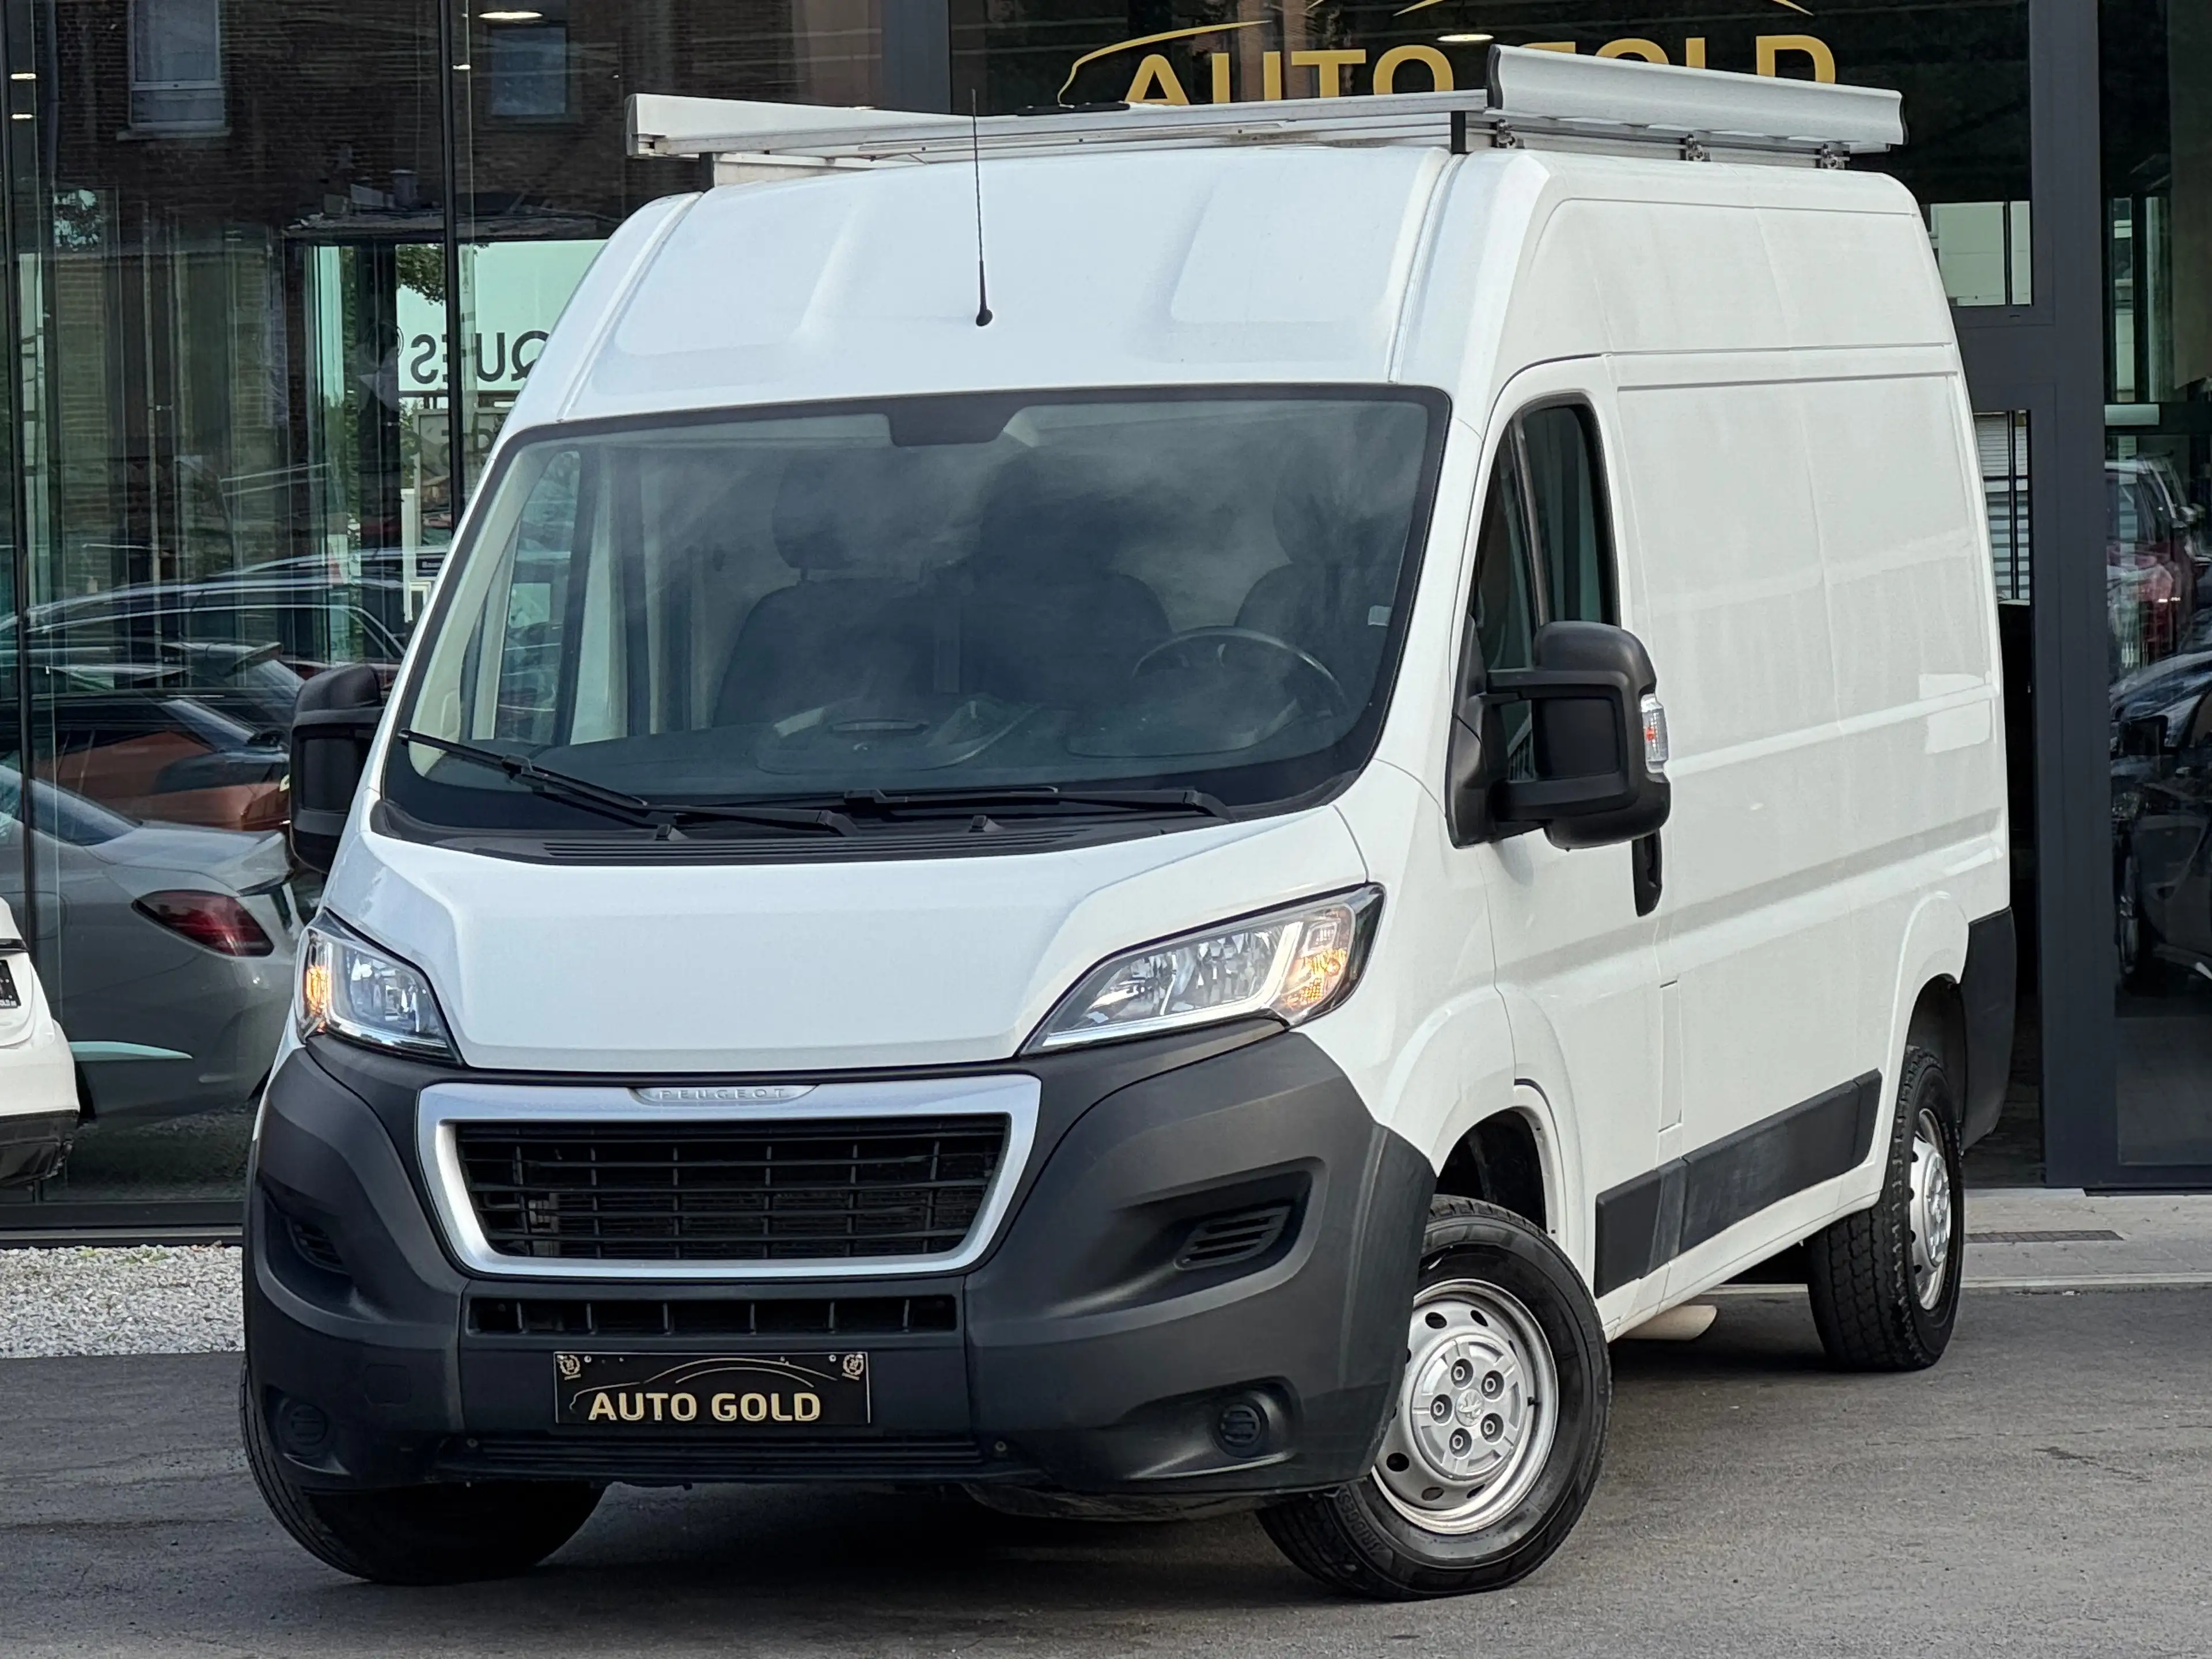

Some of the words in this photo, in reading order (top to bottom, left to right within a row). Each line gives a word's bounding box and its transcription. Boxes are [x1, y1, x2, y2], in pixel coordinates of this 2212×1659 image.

[1124, 44, 1454, 105] AUTO
[658, 1088, 786, 1100] PEUGEOT
[588, 1392, 697, 1422] AUTO
[711, 1392, 821, 1422] GOLD
